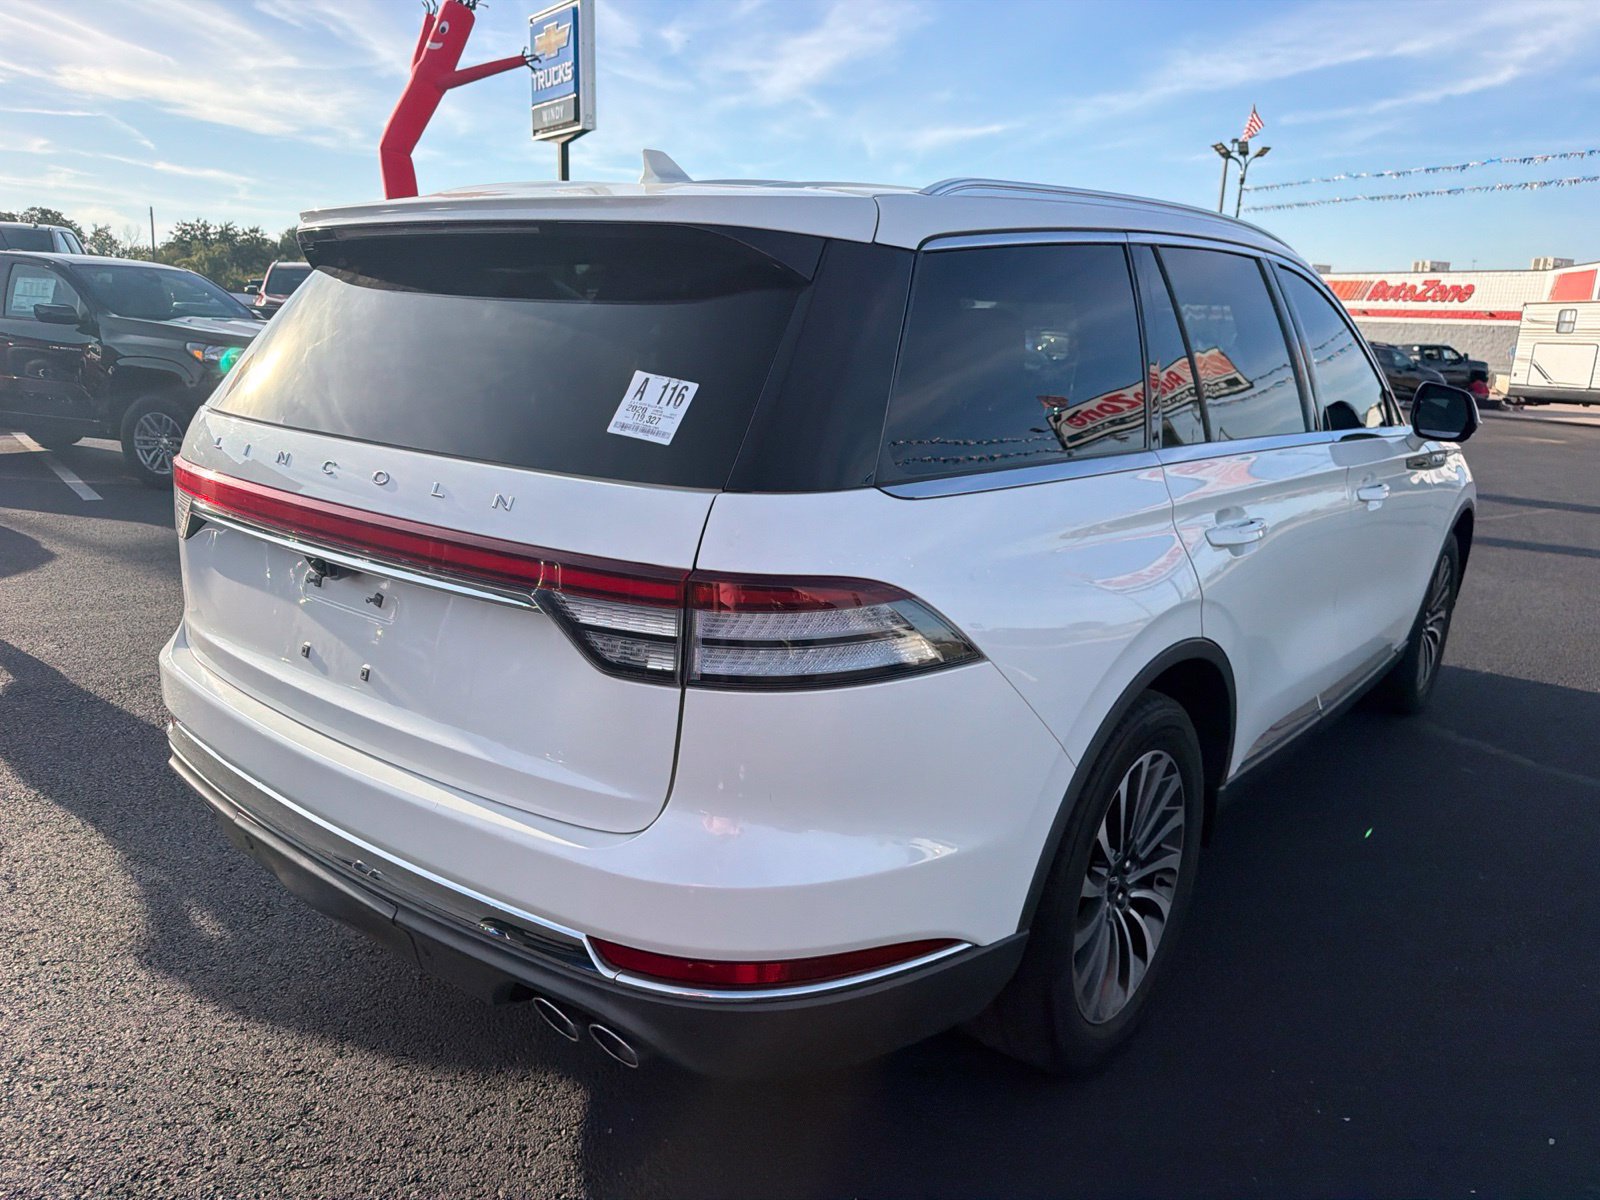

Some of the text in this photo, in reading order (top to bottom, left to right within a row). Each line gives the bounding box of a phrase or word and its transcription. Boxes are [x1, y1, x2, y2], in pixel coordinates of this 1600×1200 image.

[531, 61, 573, 91] TRUCKS
[1366, 280, 1475, 302] AutoZone
[632, 377, 689, 409] A 116
[625, 404, 648, 415] 2020
[213, 437, 515, 511] LINCOLN
